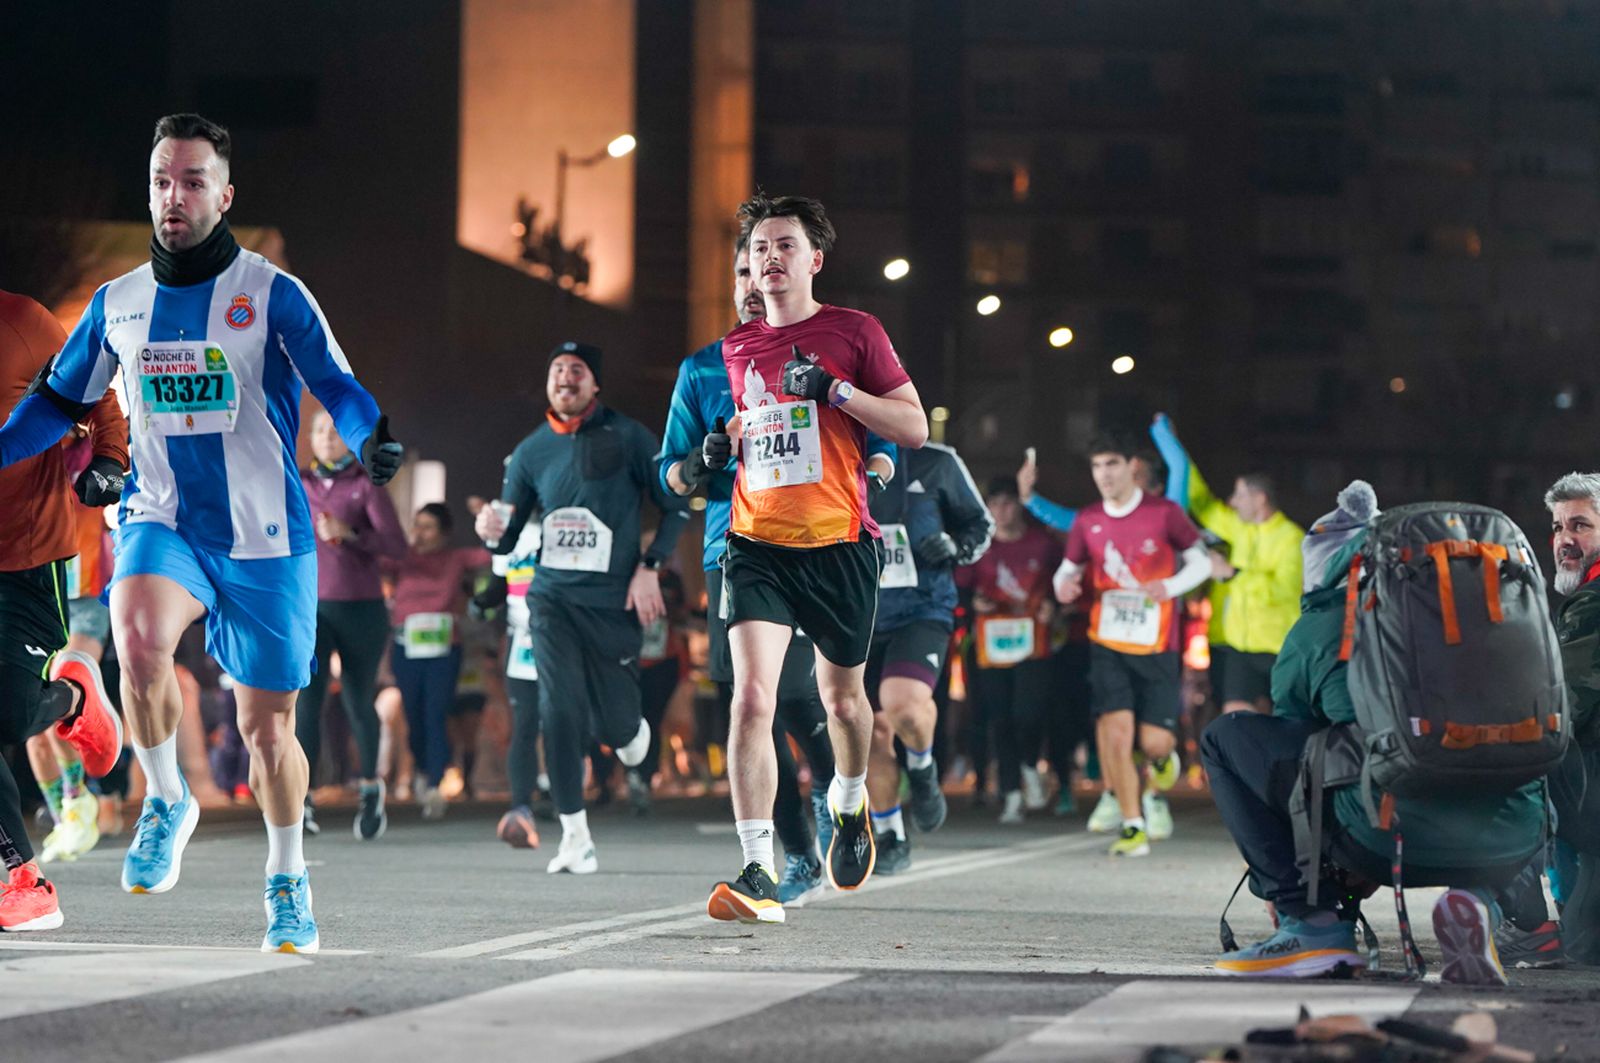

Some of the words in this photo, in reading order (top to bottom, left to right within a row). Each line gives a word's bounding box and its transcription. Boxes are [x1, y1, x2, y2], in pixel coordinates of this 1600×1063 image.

[109, 312, 146, 325] KELME
[153, 352, 183, 362] NOCHE
[185, 351, 196, 361] DE
[143, 364, 163, 375] SAN
[149, 374, 224, 404] 13327
[773, 412, 783, 423] DE
[754, 431, 801, 462] 1244
[557, 530, 598, 549] 2233
